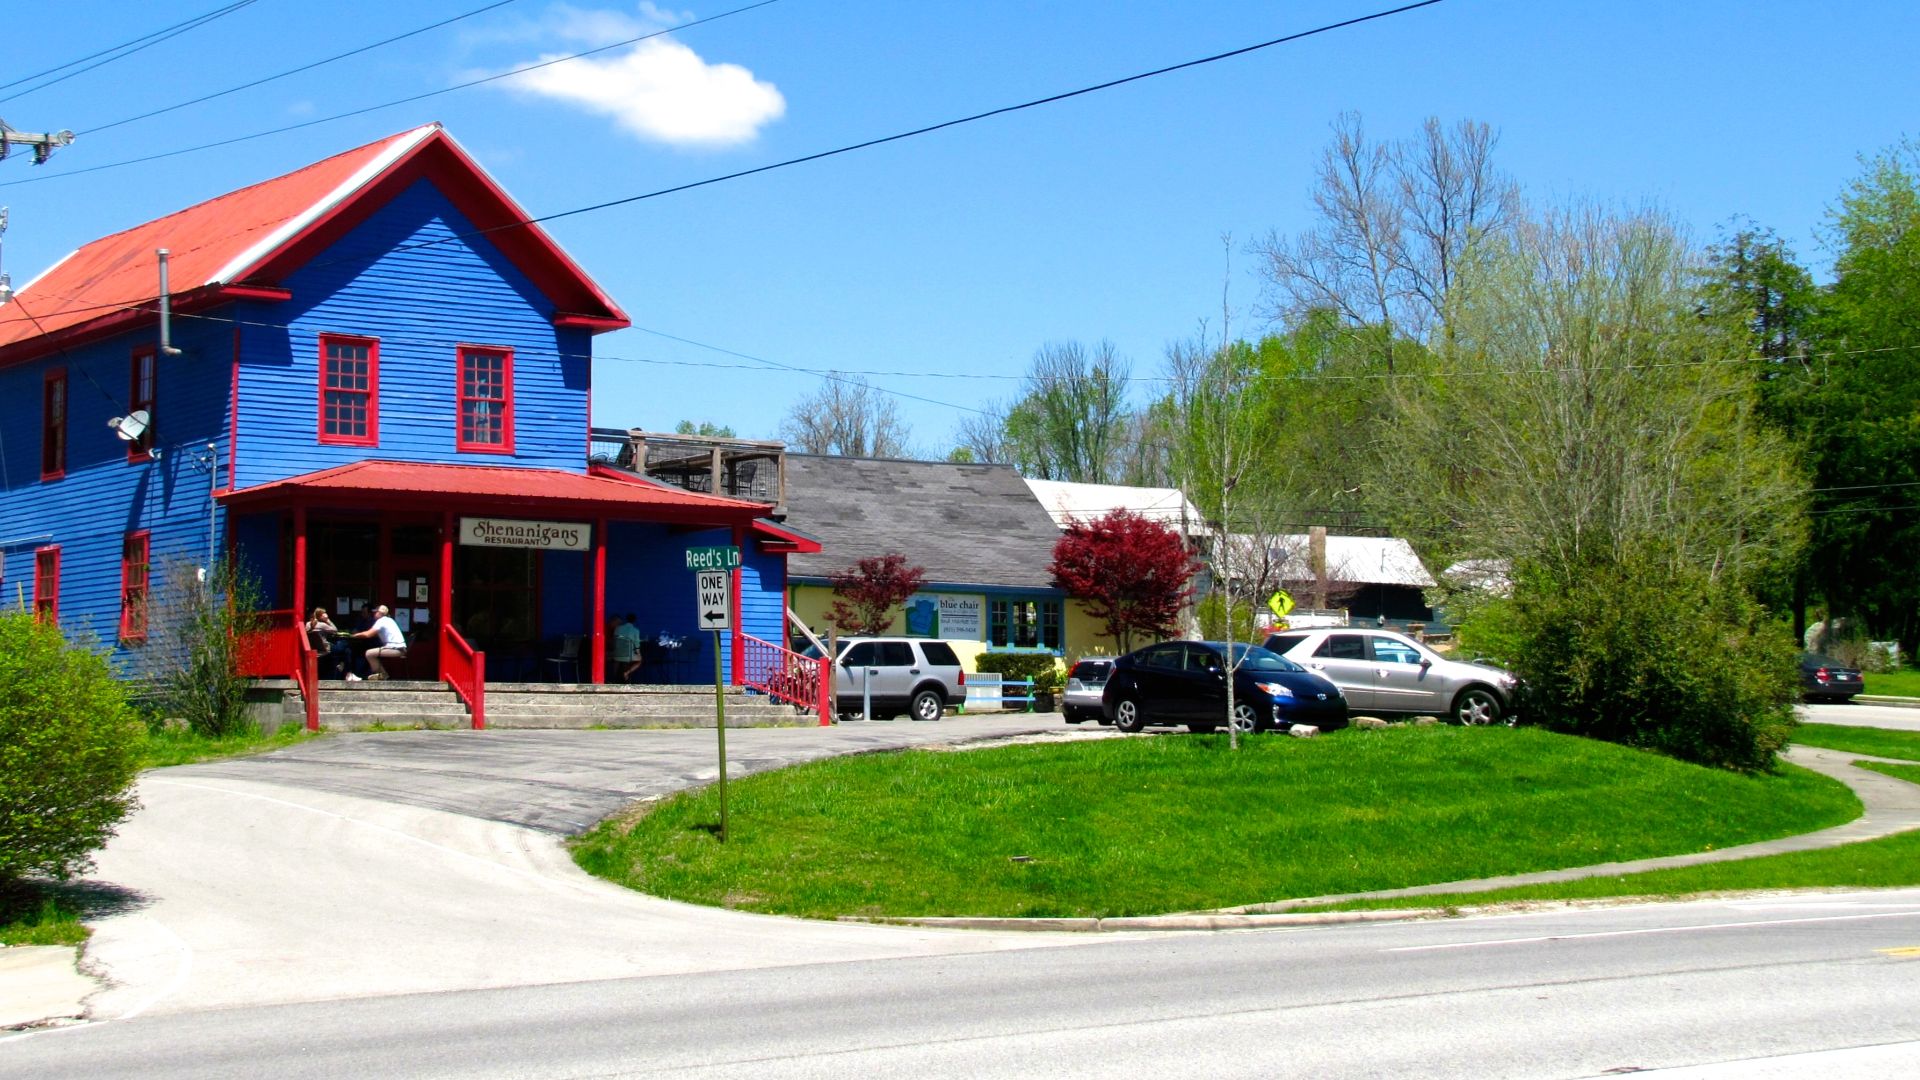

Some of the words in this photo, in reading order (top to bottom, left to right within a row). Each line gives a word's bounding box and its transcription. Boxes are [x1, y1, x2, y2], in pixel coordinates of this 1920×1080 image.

[473, 521, 579, 547] Shenanigans
[484, 536, 540, 546] RESTAURANT
[686, 548, 722, 568] Reed's
[727, 549, 740, 566] Ln
[701, 576, 723, 590] ONE
[701, 592, 725, 606] WAY
[940, 600, 958, 609] blue
[960, 600, 979, 609] chair
